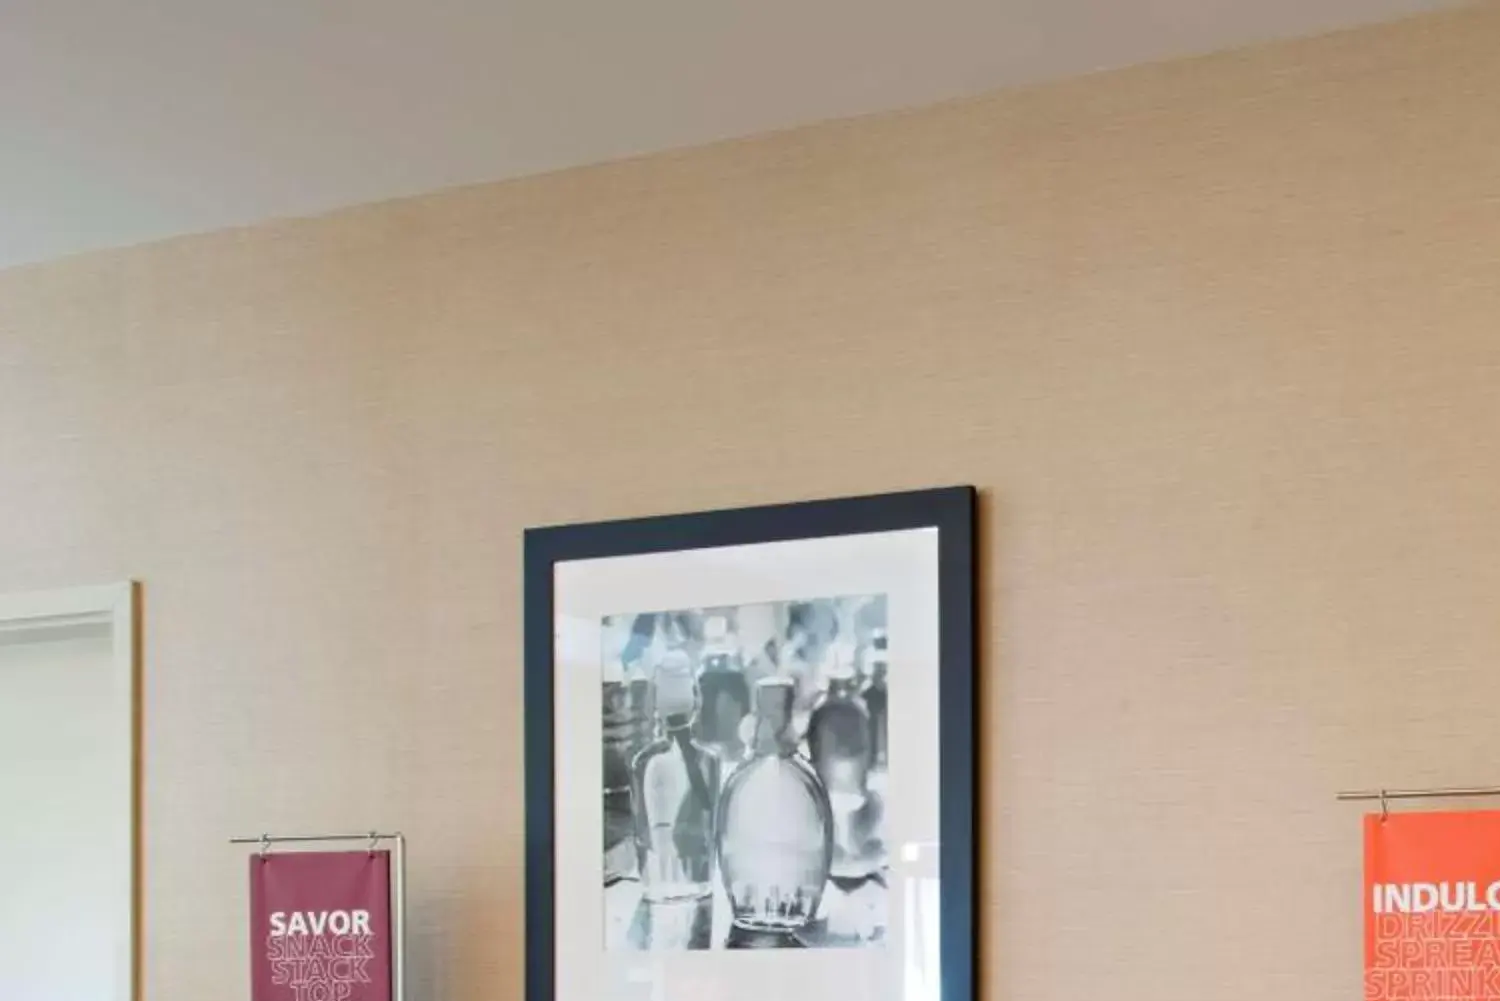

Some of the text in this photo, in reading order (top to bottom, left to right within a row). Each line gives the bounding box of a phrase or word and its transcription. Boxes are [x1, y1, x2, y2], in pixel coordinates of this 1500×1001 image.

[269, 910, 371, 936] SAVOR
[266, 934, 374, 960] SNACK
[271, 958, 371, 984] STACK
